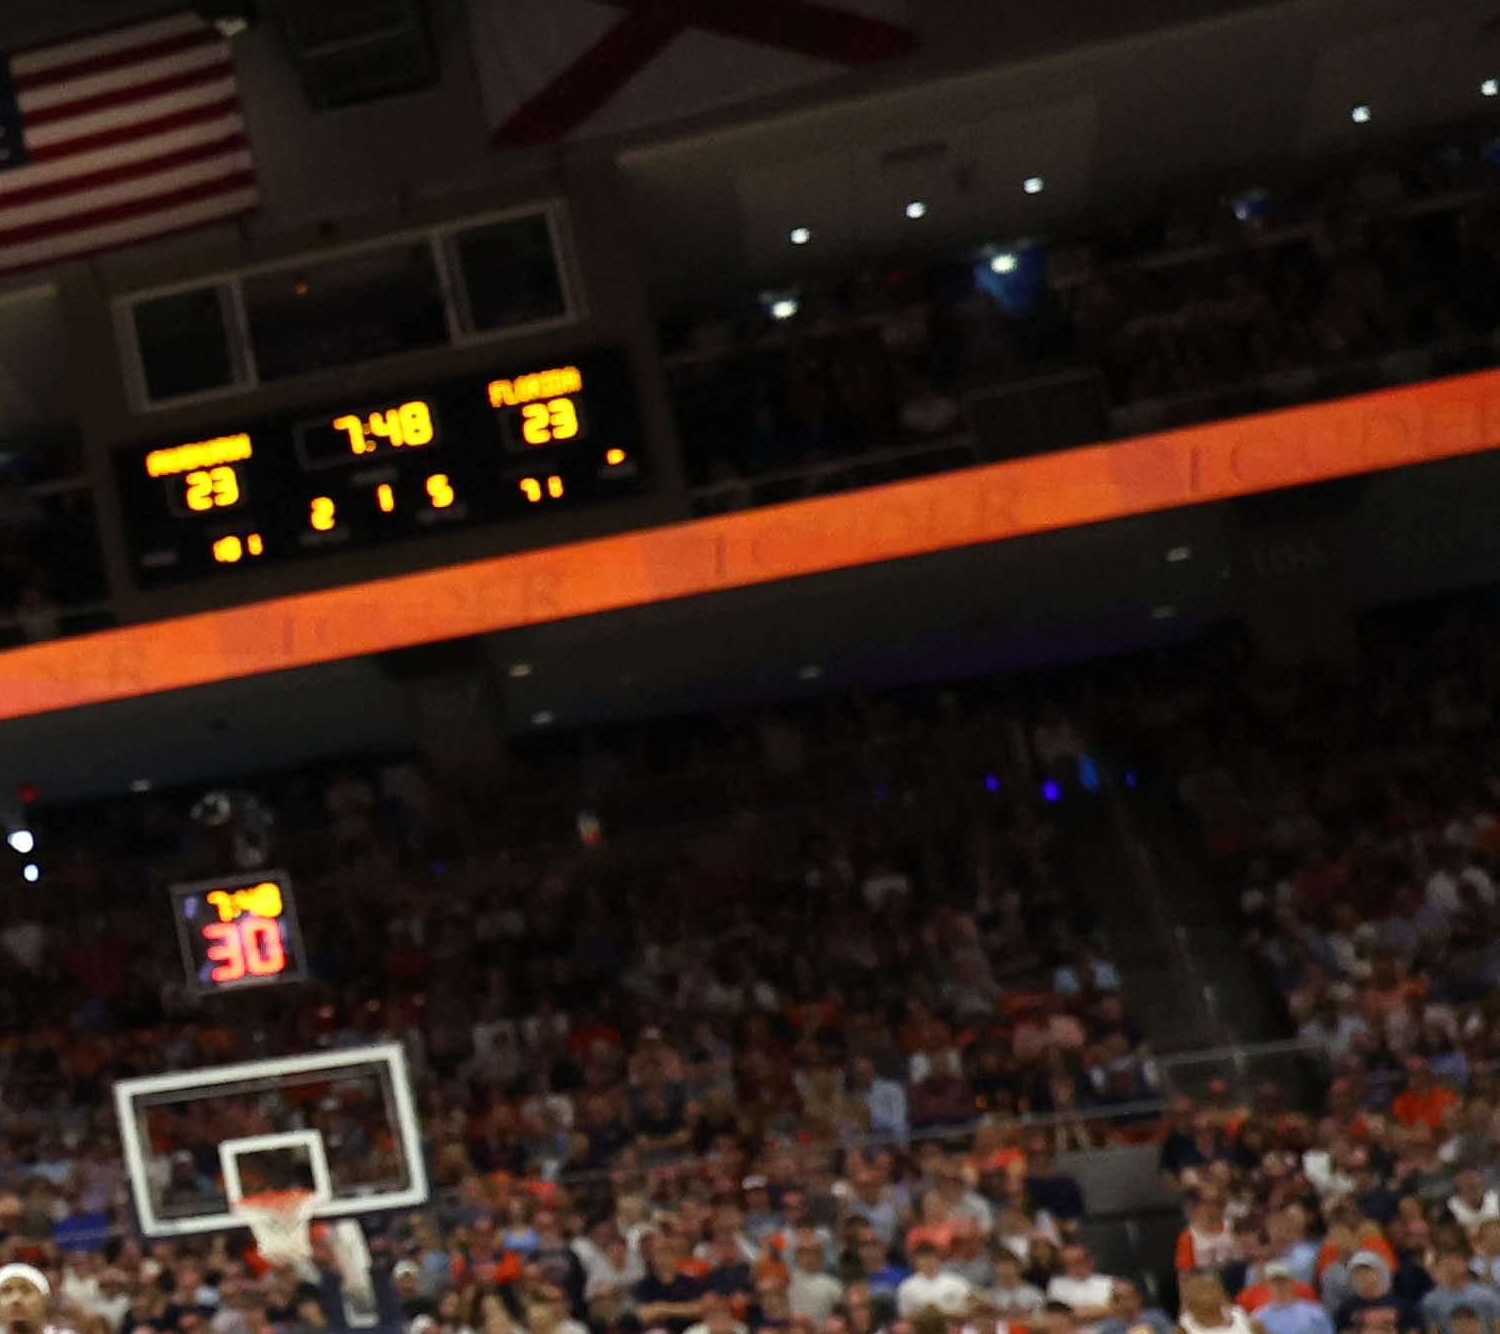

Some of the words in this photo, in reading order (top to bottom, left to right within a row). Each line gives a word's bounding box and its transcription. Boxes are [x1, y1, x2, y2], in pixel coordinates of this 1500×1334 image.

[332, 400, 435, 455] 7:48
[520, 397, 580, 445] 23
[184, 466, 241, 512] 23
[202, 916, 286, 982] 30
